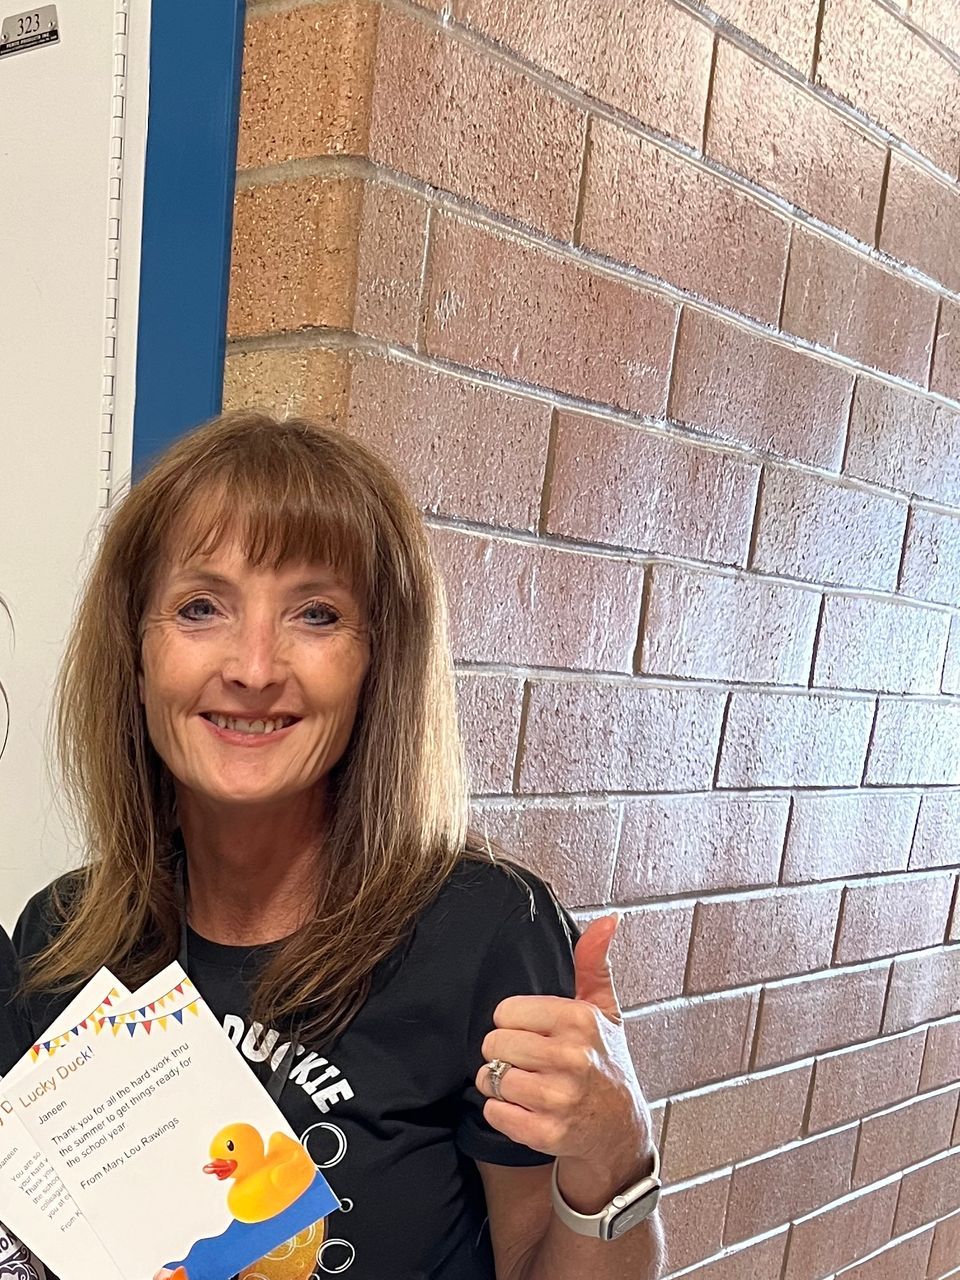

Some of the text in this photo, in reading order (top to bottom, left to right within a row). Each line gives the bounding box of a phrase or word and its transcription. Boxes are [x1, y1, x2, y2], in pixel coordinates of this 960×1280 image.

[17, 13, 39, 36] 323
[19, 1045, 95, 1108] Lucky Duck!
[51, 1042, 189, 1145] Thank you for all the hard work thru
[59, 1057, 192, 1157] the summer to get things ready for
[39, 1100, 67, 1125] Janeen
[66, 1122, 126, 1168] the school year
[80, 1117, 180, 1190] From Mary Lou Rawlings
[11, 1169, 24, 1182] You
[24, 1159, 34, 1171] are
[19, 1161, 44, 1192] your hard
[25, 1166, 55, 1196] Thank you
[32, 1193, 43, 1205] the
[48, 1206, 59, 1219] you
[60, 1215, 77, 1232] From
